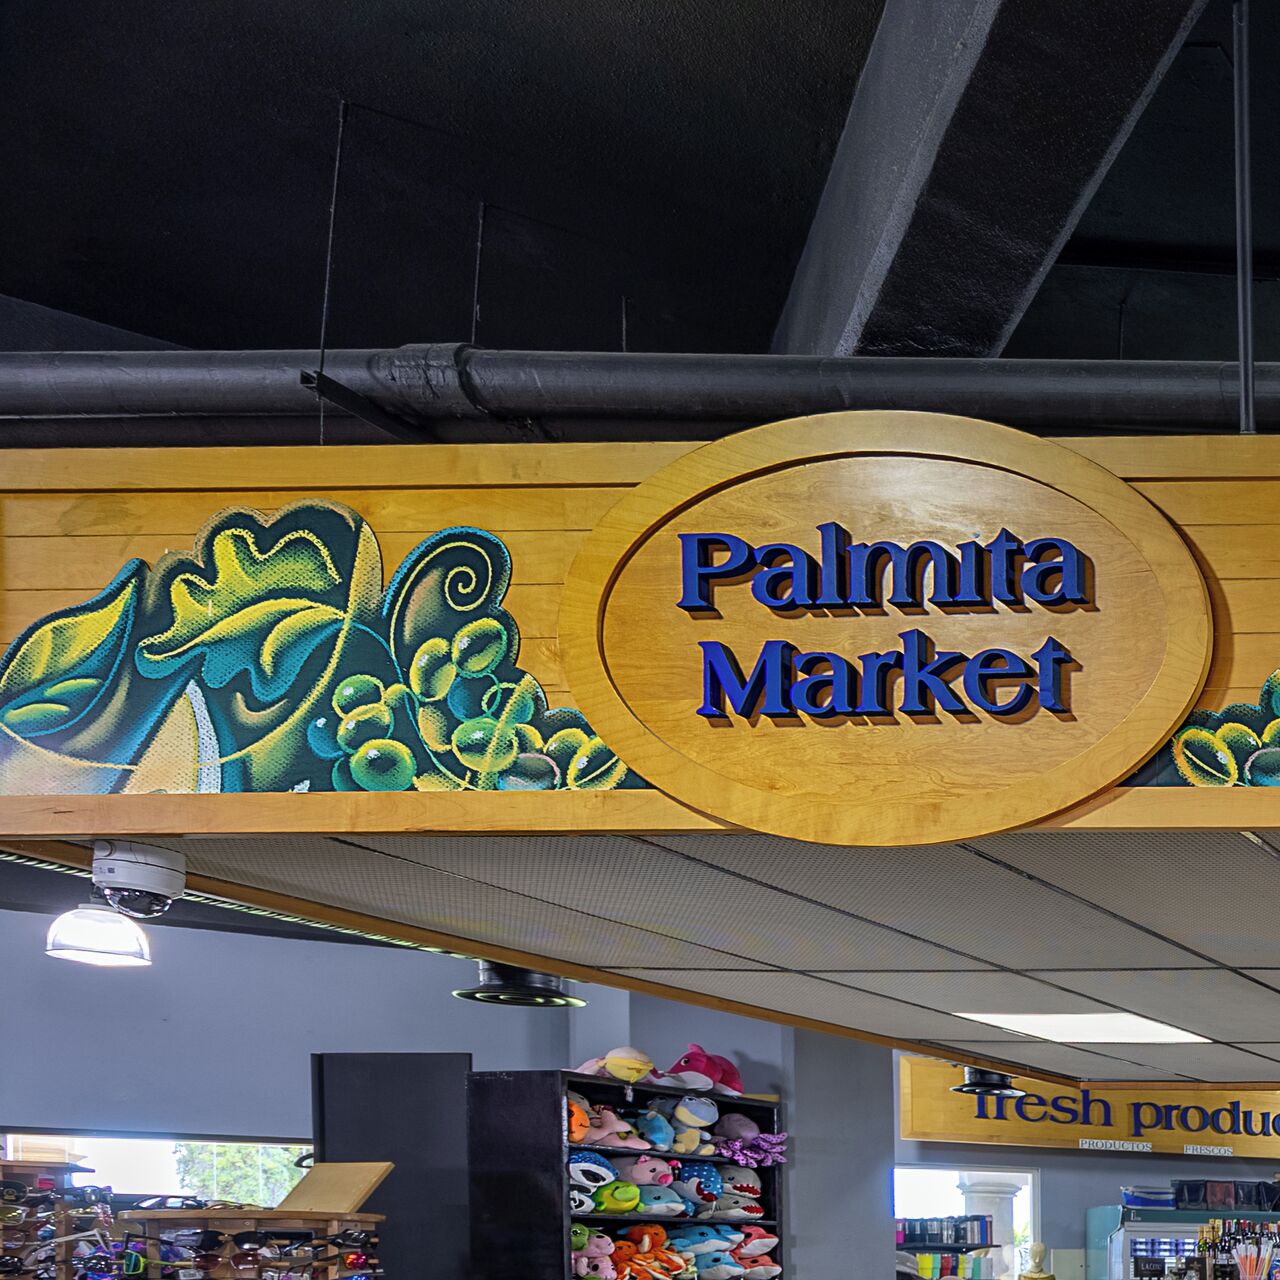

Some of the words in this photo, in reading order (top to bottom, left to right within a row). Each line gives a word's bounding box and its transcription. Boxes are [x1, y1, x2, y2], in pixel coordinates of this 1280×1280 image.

[675, 521, 1090, 612] Palmita
[696, 628, 1073, 720] Market
[1080, 1139, 1152, 1152] PRODUCTOS
[1184, 1145, 1233, 1156] FRESCOS
